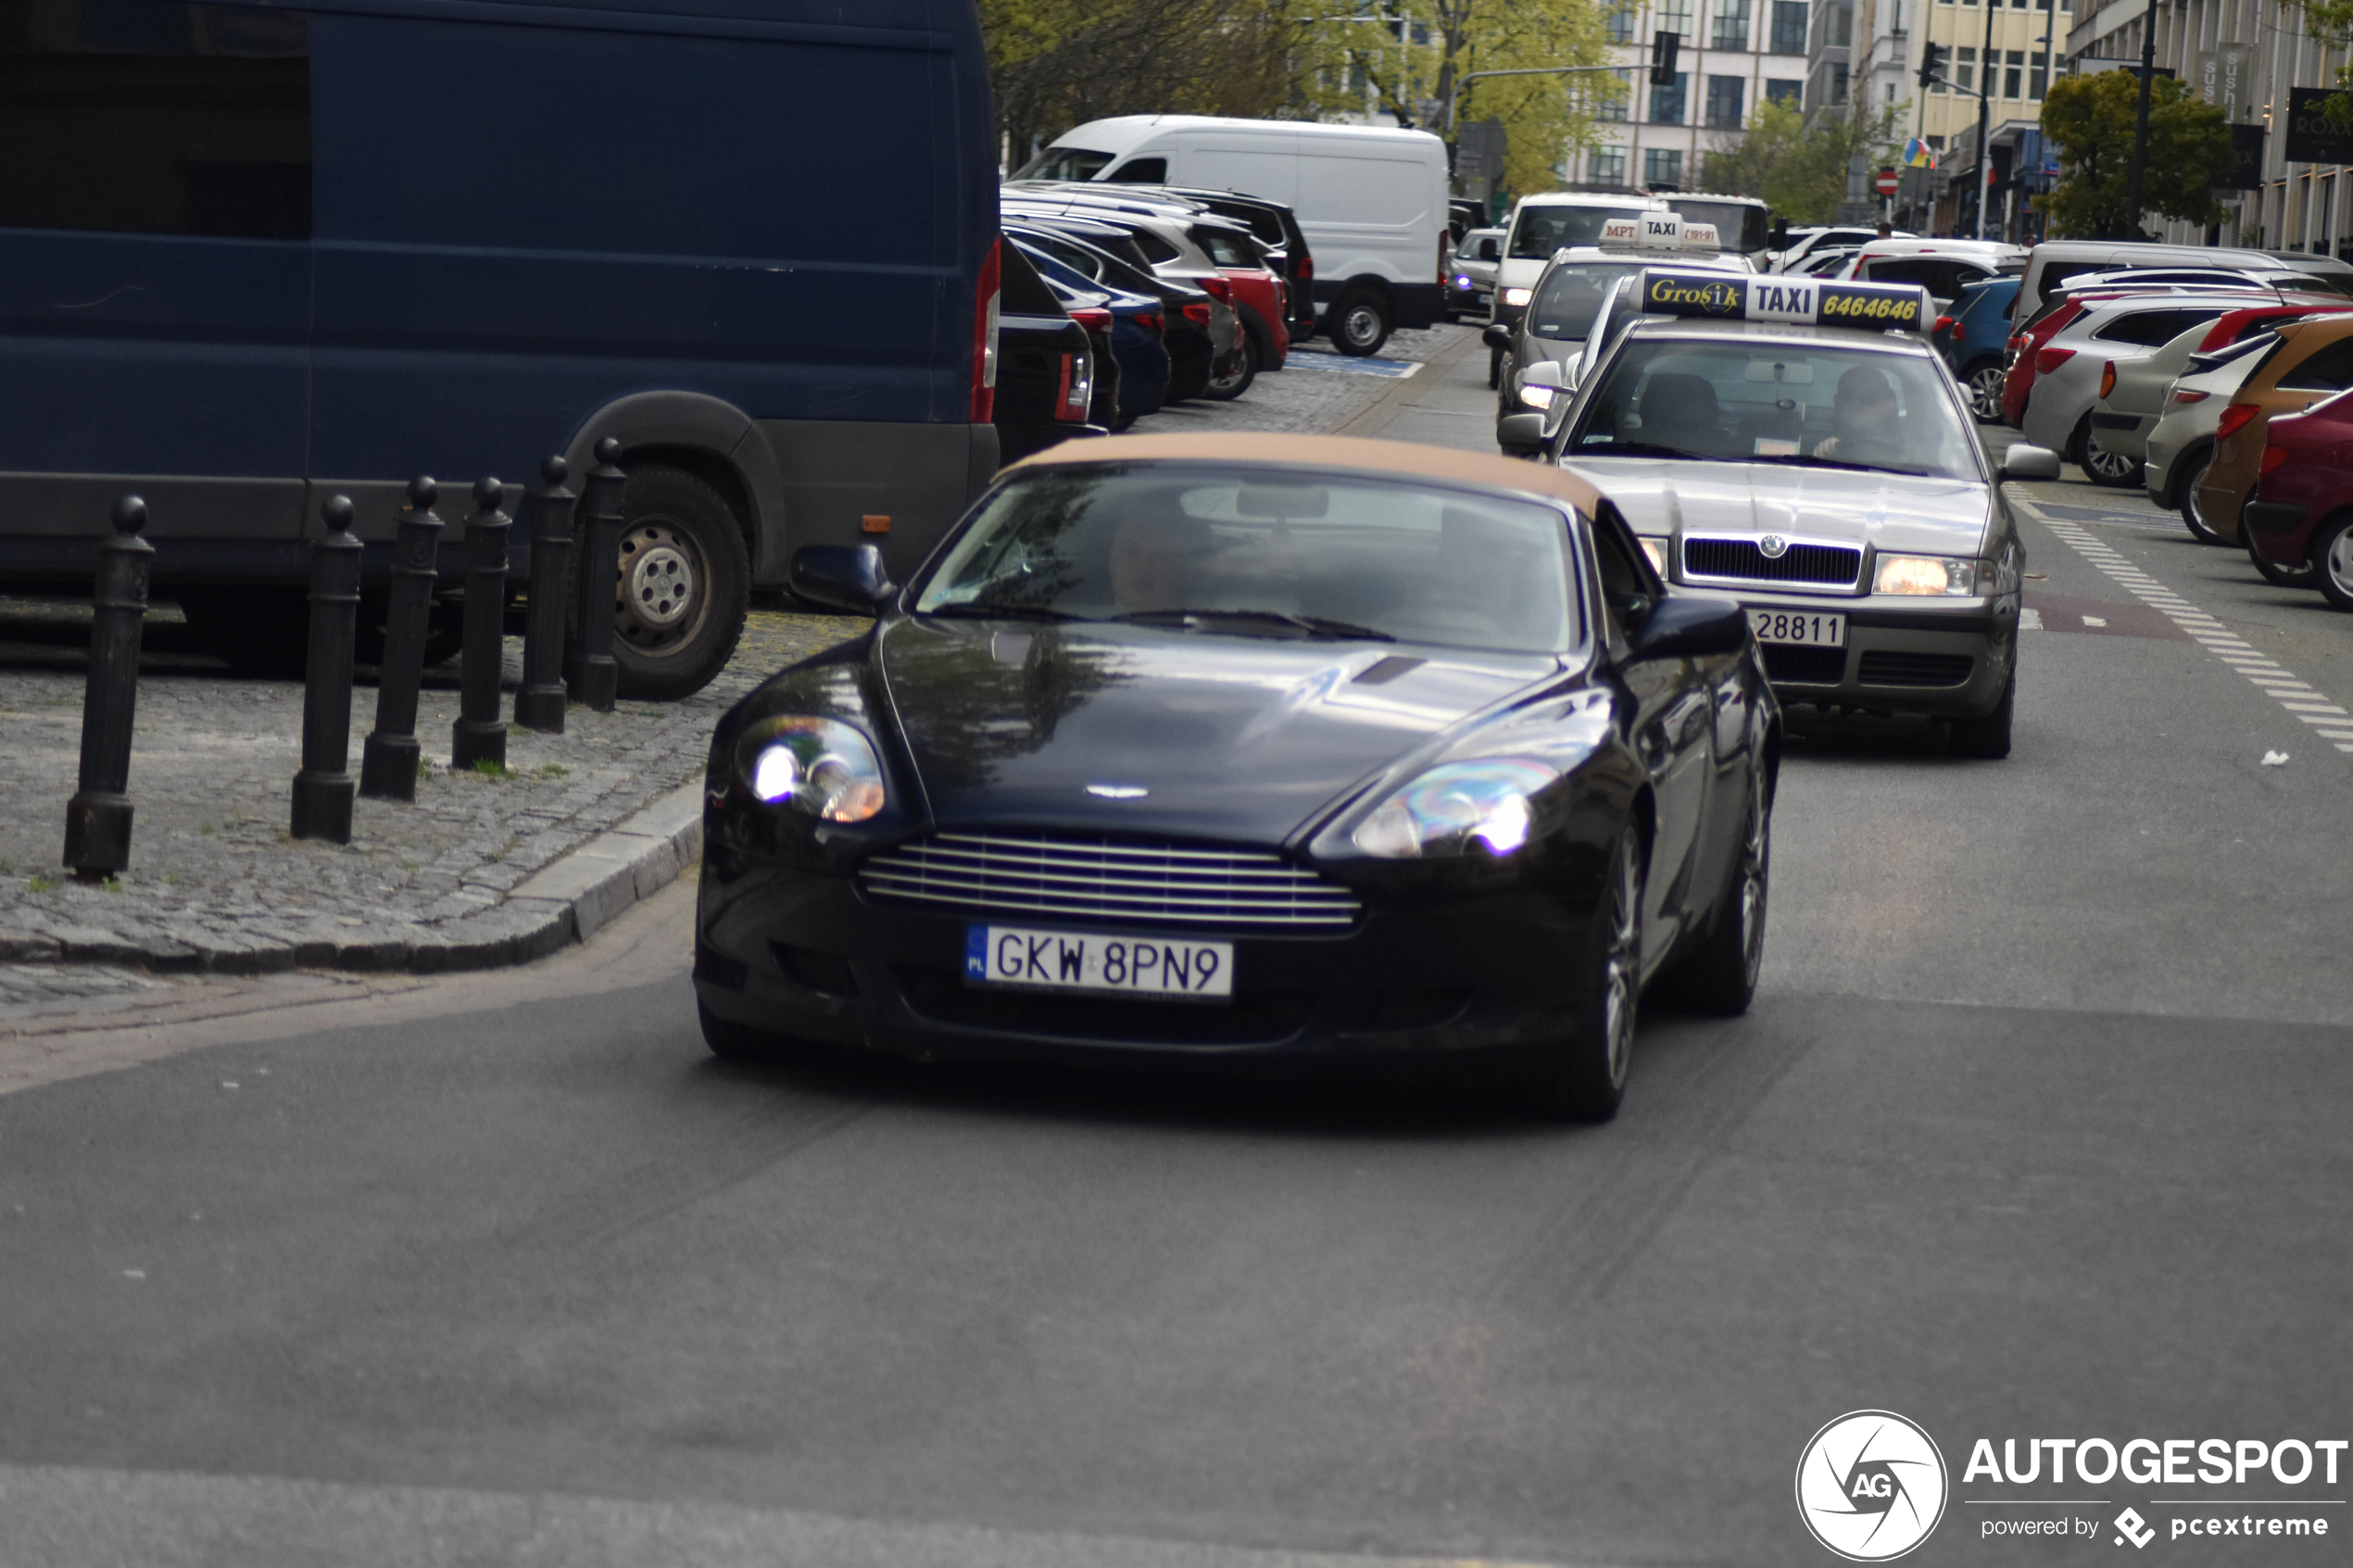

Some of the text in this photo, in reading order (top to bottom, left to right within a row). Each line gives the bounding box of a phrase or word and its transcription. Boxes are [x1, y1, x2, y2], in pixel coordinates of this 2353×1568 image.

[2204, 61, 2216, 104] sus
[1606, 225, 1635, 238] MPT
[1647, 221, 1676, 235] TAXI
[1651, 279, 1917, 320] Grosik TAXI 6464646
[1756, 613, 1838, 643] 28811
[968, 958, 984, 972] PL
[997, 934, 1219, 991] GKW 8PN9
